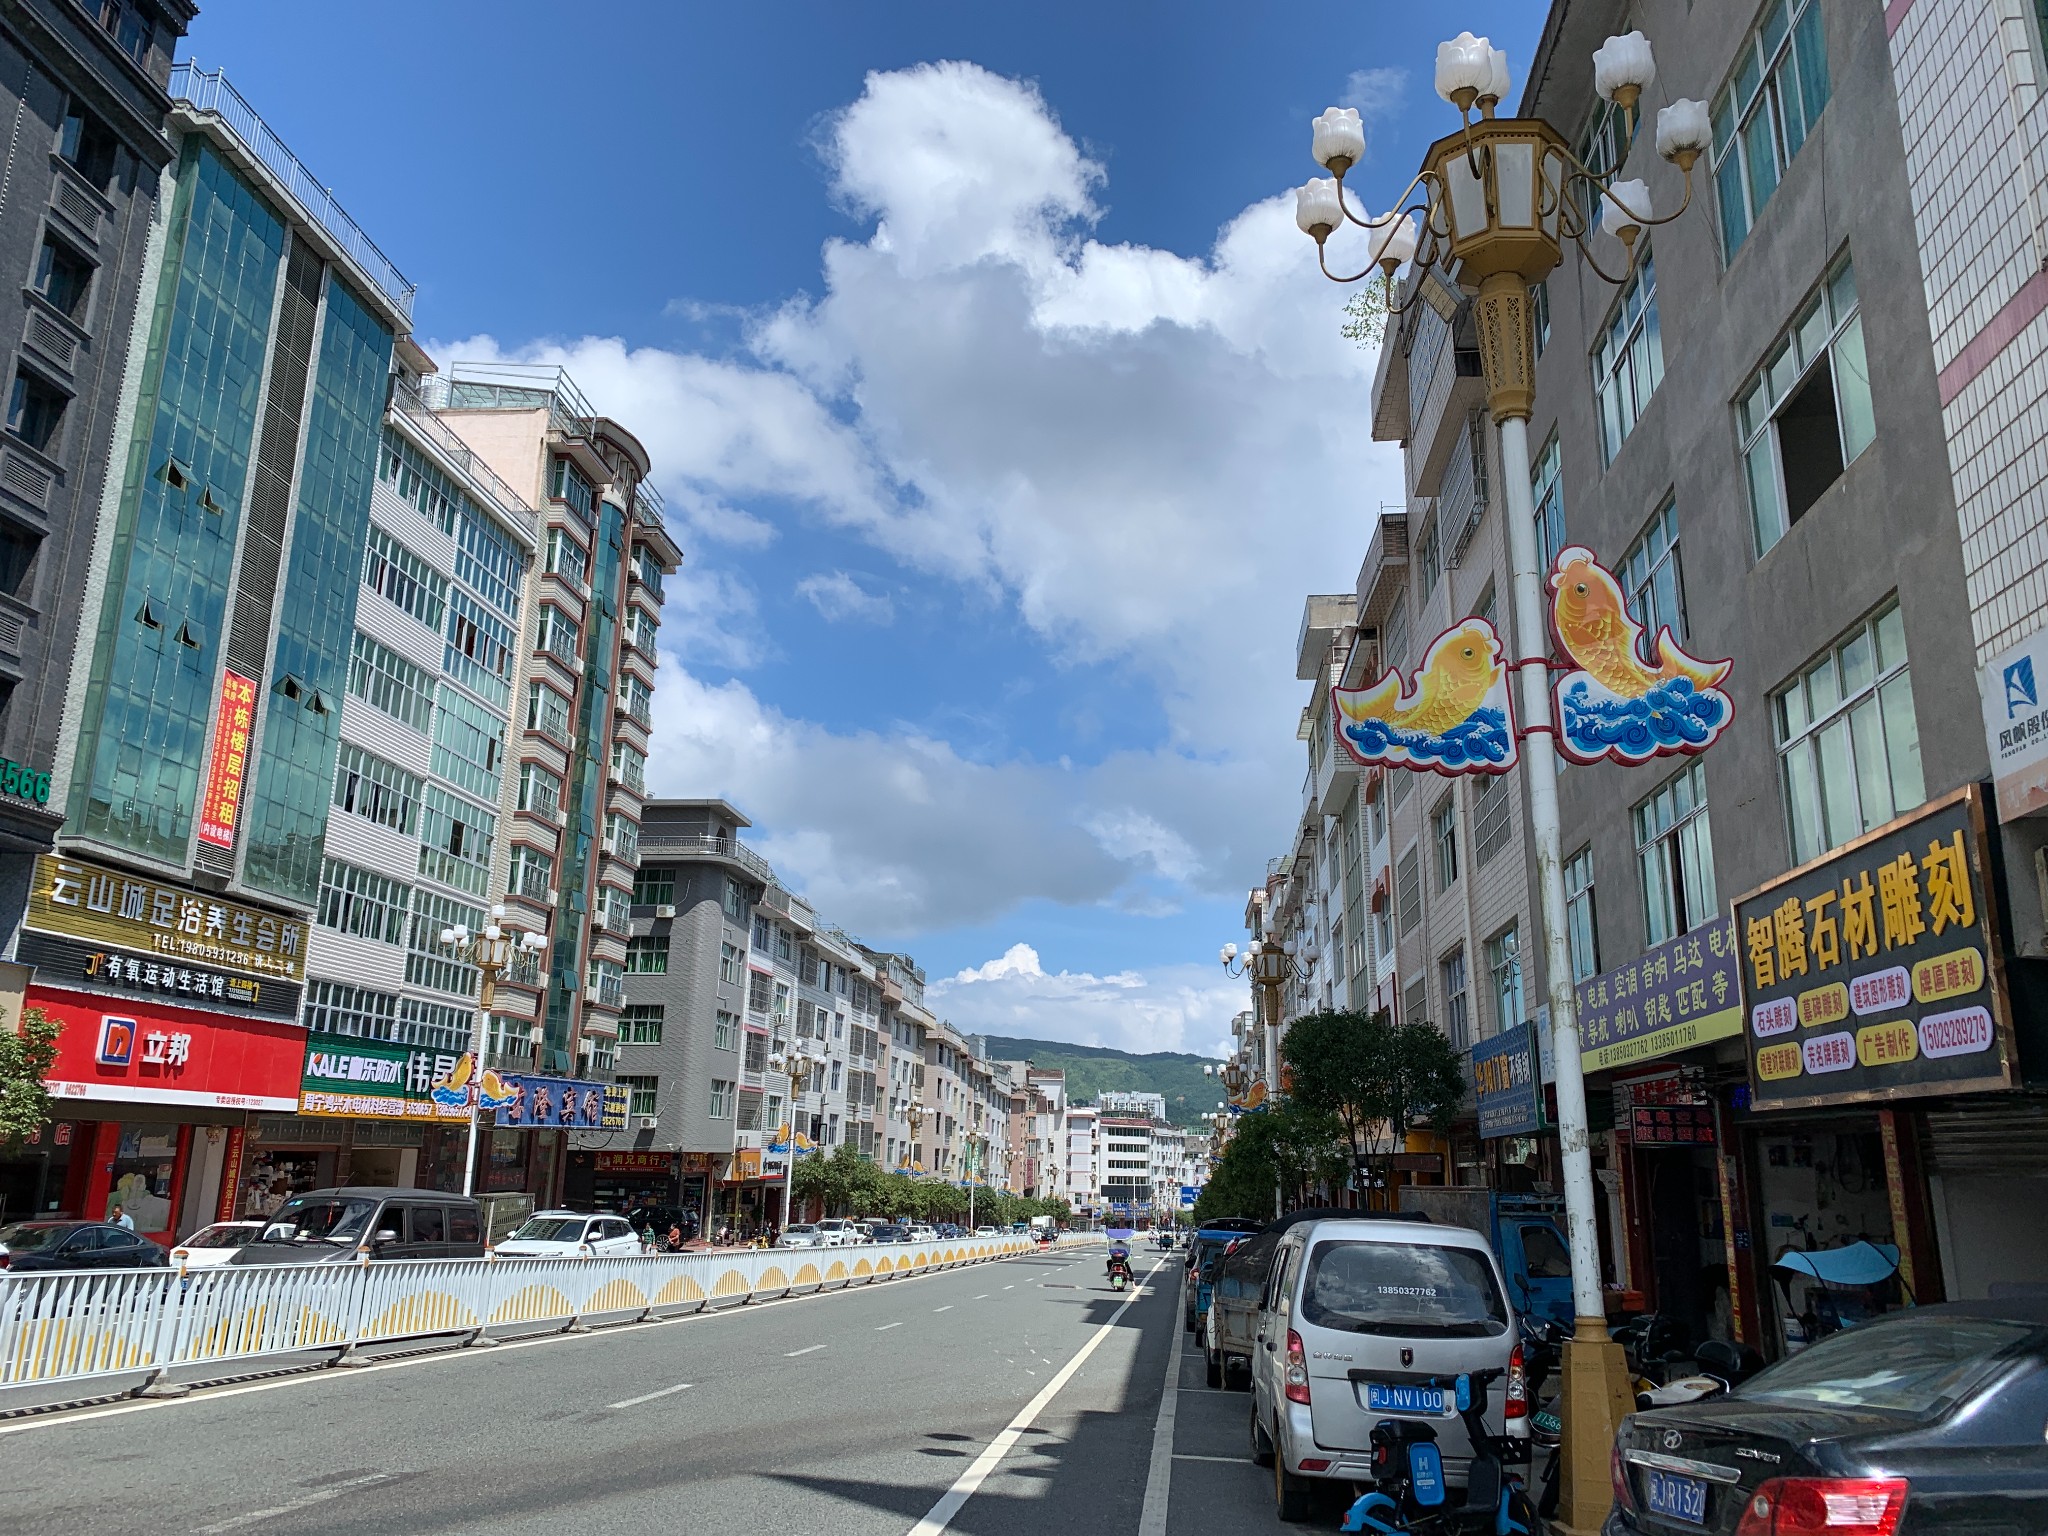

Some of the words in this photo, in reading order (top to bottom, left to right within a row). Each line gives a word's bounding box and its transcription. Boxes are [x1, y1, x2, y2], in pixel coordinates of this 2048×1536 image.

[219, 683, 252, 825] 本栋楼层招租
[0, 757, 50, 803] 566
[50, 864, 300, 956] 云山城足浴养生会所
[1747, 829, 1975, 989] 智腾石材雕刻
[107, 954, 224, 997] 有氧运动生活馆
[1587, 981, 1609, 1010] 电瓶
[1614, 967, 1638, 1000] 空调
[1642, 952, 1668, 989] 音响
[1674, 936, 1704, 975] 马达
[1588, 1016, 1610, 1046] 导航
[1615, 1005, 1640, 1036] 喇叭
[1644, 993, 1672, 1027] 钥匙
[1675, 978, 1708, 1016] 匹配
[1711, 968, 1729, 1005] 等
[1757, 1003, 1793, 1032] 石头雕刻
[143, 1030, 191, 1066] 立邦
[1650, 1024, 1697, 1050] 13385011760
[1862, 1029, 1911, 1061] 广告制作
[1922, 1014, 1987, 1052] 15029289279
[306, 1052, 347, 1079] KALE
[1807, 1038, 1850, 1069] 芳名牌雕刻
[1377, 1286, 1437, 1297] 13850327762
